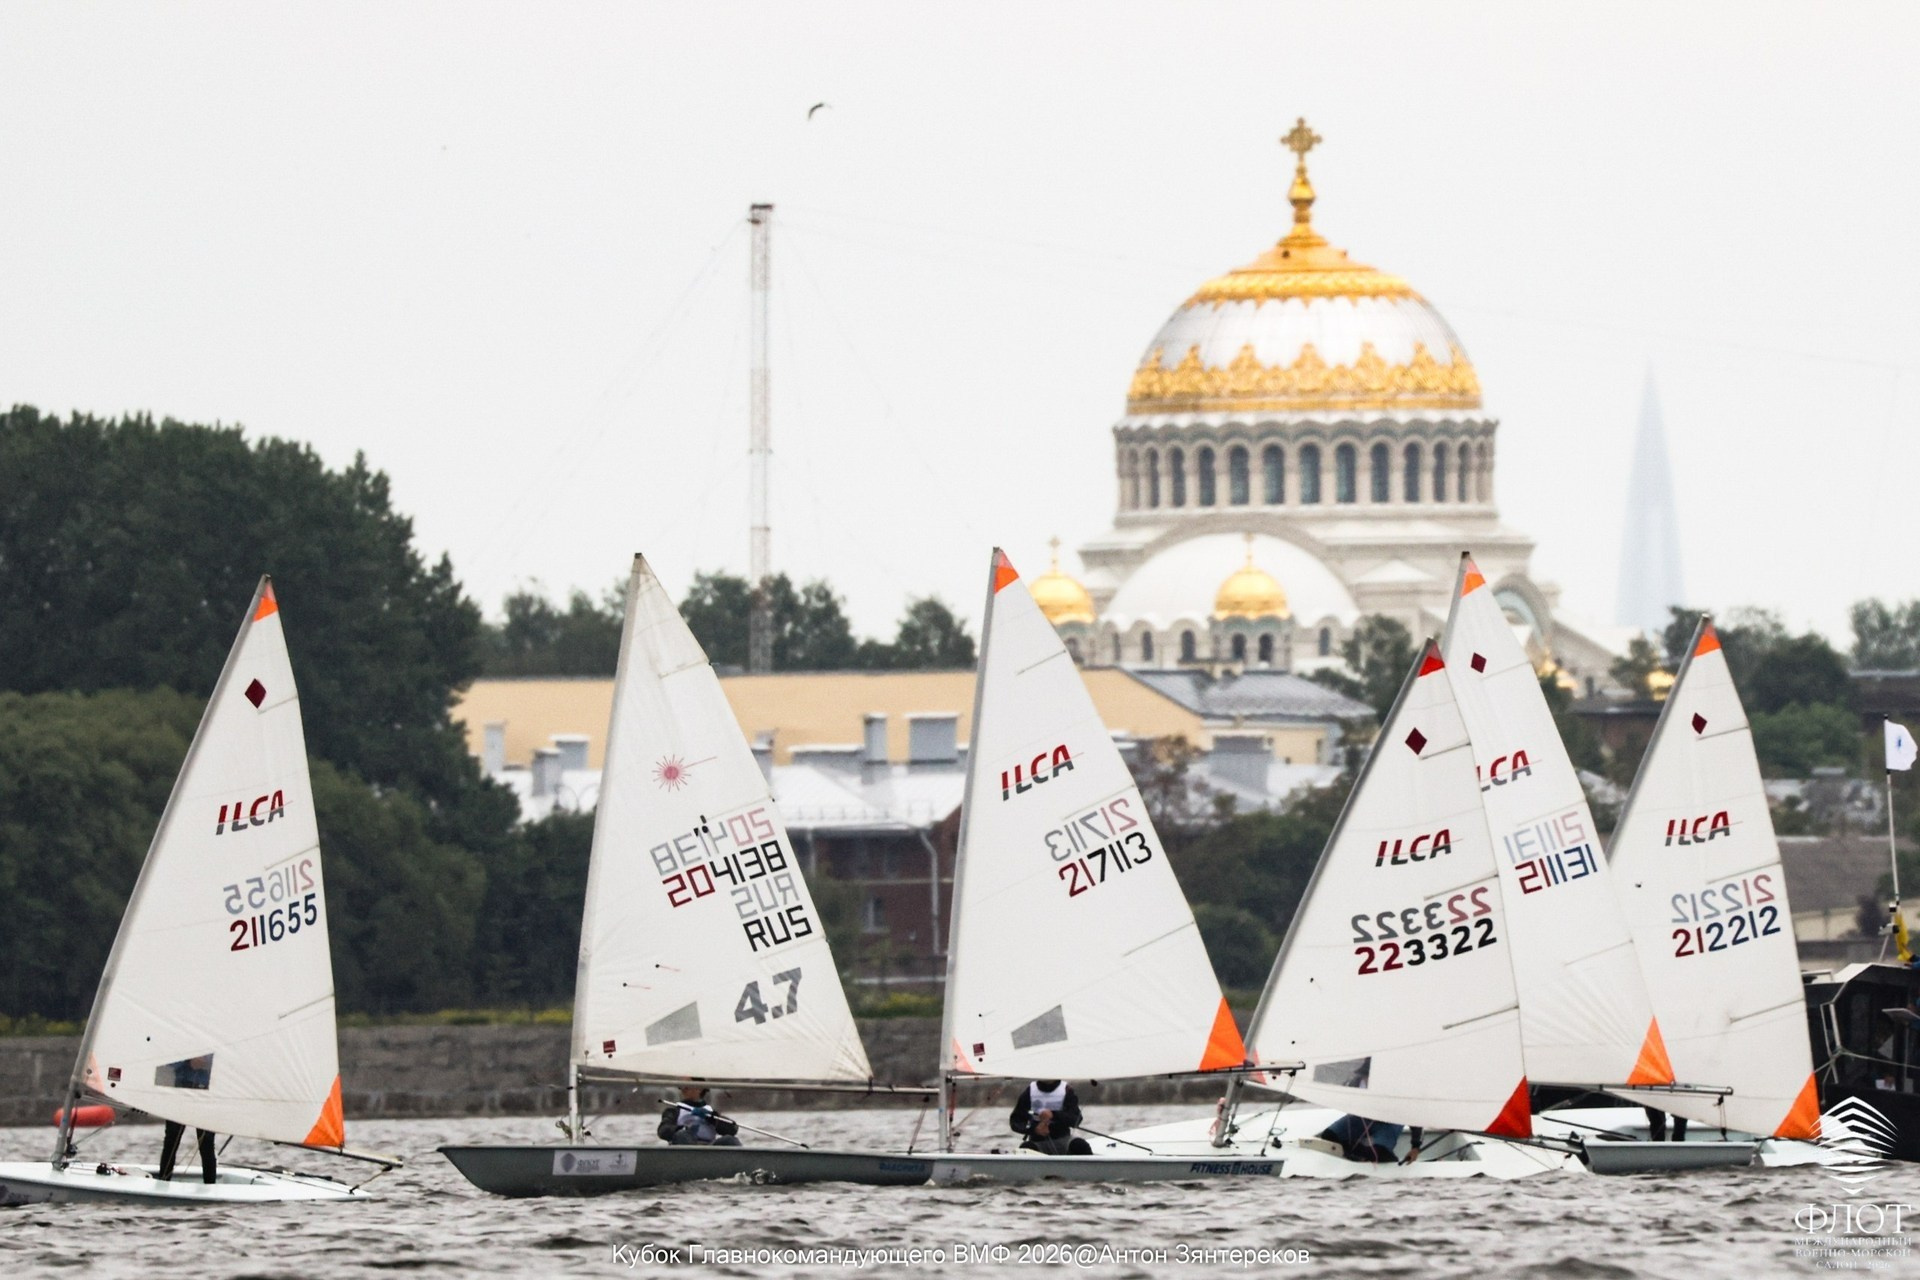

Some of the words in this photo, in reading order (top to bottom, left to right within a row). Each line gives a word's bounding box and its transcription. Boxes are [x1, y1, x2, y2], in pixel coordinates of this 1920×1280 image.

[1001, 744, 1075, 801] ILCA
[1476, 750, 1532, 792] LCA
[216, 789, 285, 835] ILCA
[1665, 810, 1731, 846] ILCA
[662, 839, 788, 908] 204138
[1058, 832, 1152, 898] 217113
[1375, 828, 1452, 867] ILCA
[1514, 843, 1598, 894] 211131
[229, 892, 318, 952] 211655
[742, 904, 813, 952] RUS
[1354, 917, 1497, 976] 223322
[1672, 905, 1781, 958] 212212
[734, 966, 803, 1025] 4.7
[1190, 1162, 1231, 1175] FITNESS
[1241, 1163, 1273, 1175] HOUSE
